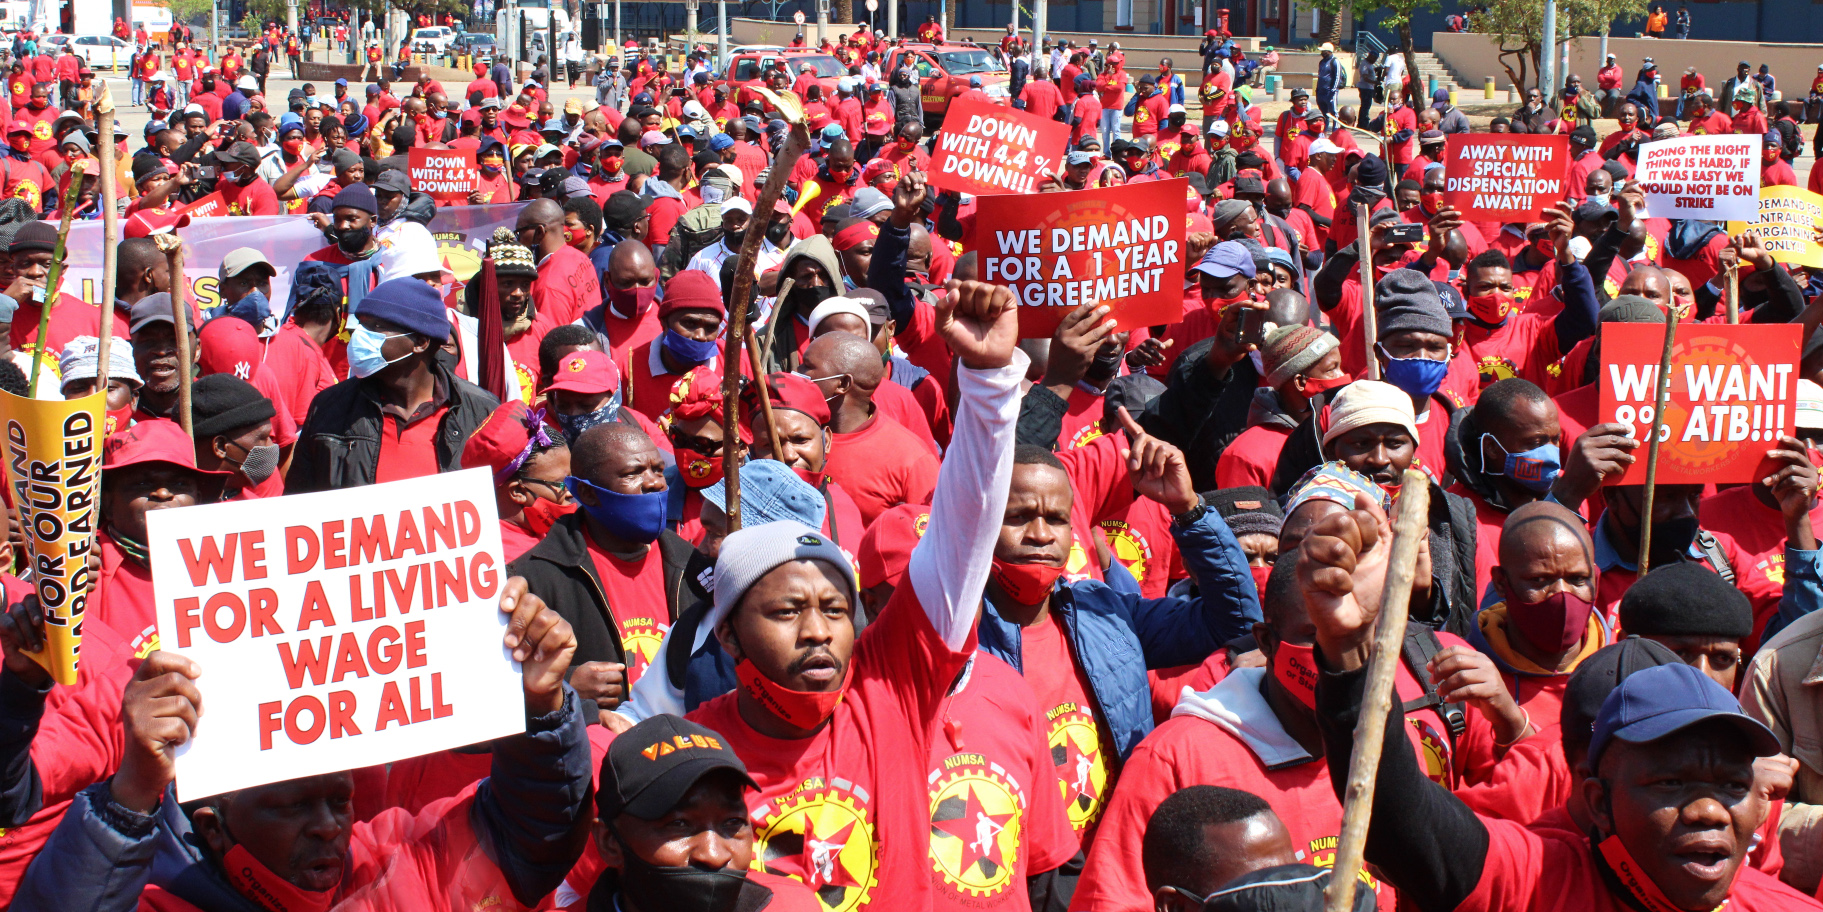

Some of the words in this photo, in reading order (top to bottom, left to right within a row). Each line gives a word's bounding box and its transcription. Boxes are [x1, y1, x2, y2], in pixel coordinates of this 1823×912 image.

[967, 115, 1038, 148] DOWN
[426, 156, 466, 168] DOWN
[942, 132, 990, 160] WITH
[994, 146, 1028, 168] 4.4
[1034, 155, 1051, 178] %
[1460, 145, 1507, 160] AWAY
[1512, 146, 1552, 162] WITH
[1648, 146, 1686, 160] DOING
[1690, 145, 1712, 155] THE
[1714, 145, 1750, 156] RIGHT
[412, 168, 442, 180] WITH
[446, 170, 464, 180] 4.4
[466, 168, 476, 180] %
[943, 154, 1034, 192] DOWN!!!
[1474, 162, 1536, 178] SPECIAL
[1646, 158, 1681, 170] THING
[1685, 158, 1696, 168] IS
[1699, 158, 1736, 170] HARD,
[1740, 158, 1750, 168] IF
[418, 180, 470, 192] DOWN!!!
[1448, 178, 1560, 194] DISPENSATION
[1648, 170, 1657, 180] IT
[1661, 170, 1688, 181] WAS
[1692, 170, 1722, 182] EASY
[1725, 172, 1744, 182] WE
[1639, 183, 1682, 194] WOULD
[1686, 184, 1712, 195] NOT
[1716, 184, 1729, 196] BE
[1732, 185, 1752, 196] ON
[194, 200, 218, 216] WITH
[1472, 194, 1532, 210] AWAY!!
[1675, 196, 1714, 208] STRIKE
[1807, 203, 1822, 218] FOR
[996, 229, 1041, 254] WE
[1052, 215, 1170, 253] DEMAND
[1764, 240, 1806, 253] ONLY!!!
[986, 256, 1043, 281] FOR
[1052, 255, 1074, 280] A
[1092, 251, 1102, 276] 1
[1114, 240, 1179, 272] YEAR
[1008, 268, 1164, 306] AGREEMENT
[234, 361, 250, 380] NY
[1608, 364, 1672, 402] WE
[1684, 364, 1792, 402] WANT
[1615, 404, 1671, 442] 8%
[1682, 404, 1785, 442] ATB!!!
[7, 419, 38, 584] EMAND
[30, 459, 64, 543] OUR
[1101, 520, 1128, 530] NUMSA
[63, 410, 94, 672] RD-EARNED
[176, 530, 268, 587] WE
[284, 500, 481, 576] DEMAND
[37, 552, 68, 626] FOR
[174, 587, 284, 648] FOR
[296, 580, 336, 632] A
[349, 551, 498, 623] LIVING
[622, 618, 653, 630] NUMSA
[276, 620, 428, 690] WAGE
[1289, 657, 1318, 681] Organ
[1286, 670, 1296, 680] or
[1298, 676, 1314, 692] Sta
[754, 677, 792, 720] Organize
[258, 690, 362, 751] FOR
[375, 672, 454, 732] ALL
[1046, 702, 1078, 722] NUMSA
[641, 734, 722, 761] VALUE
[944, 754, 986, 770] NUMSA
[775, 778, 824, 804] NUMSA
[1310, 836, 1338, 852] NUM
[932, 877, 947, 894] NION
[948, 892, 958, 900] OF
[961, 898, 985, 909] METAL
